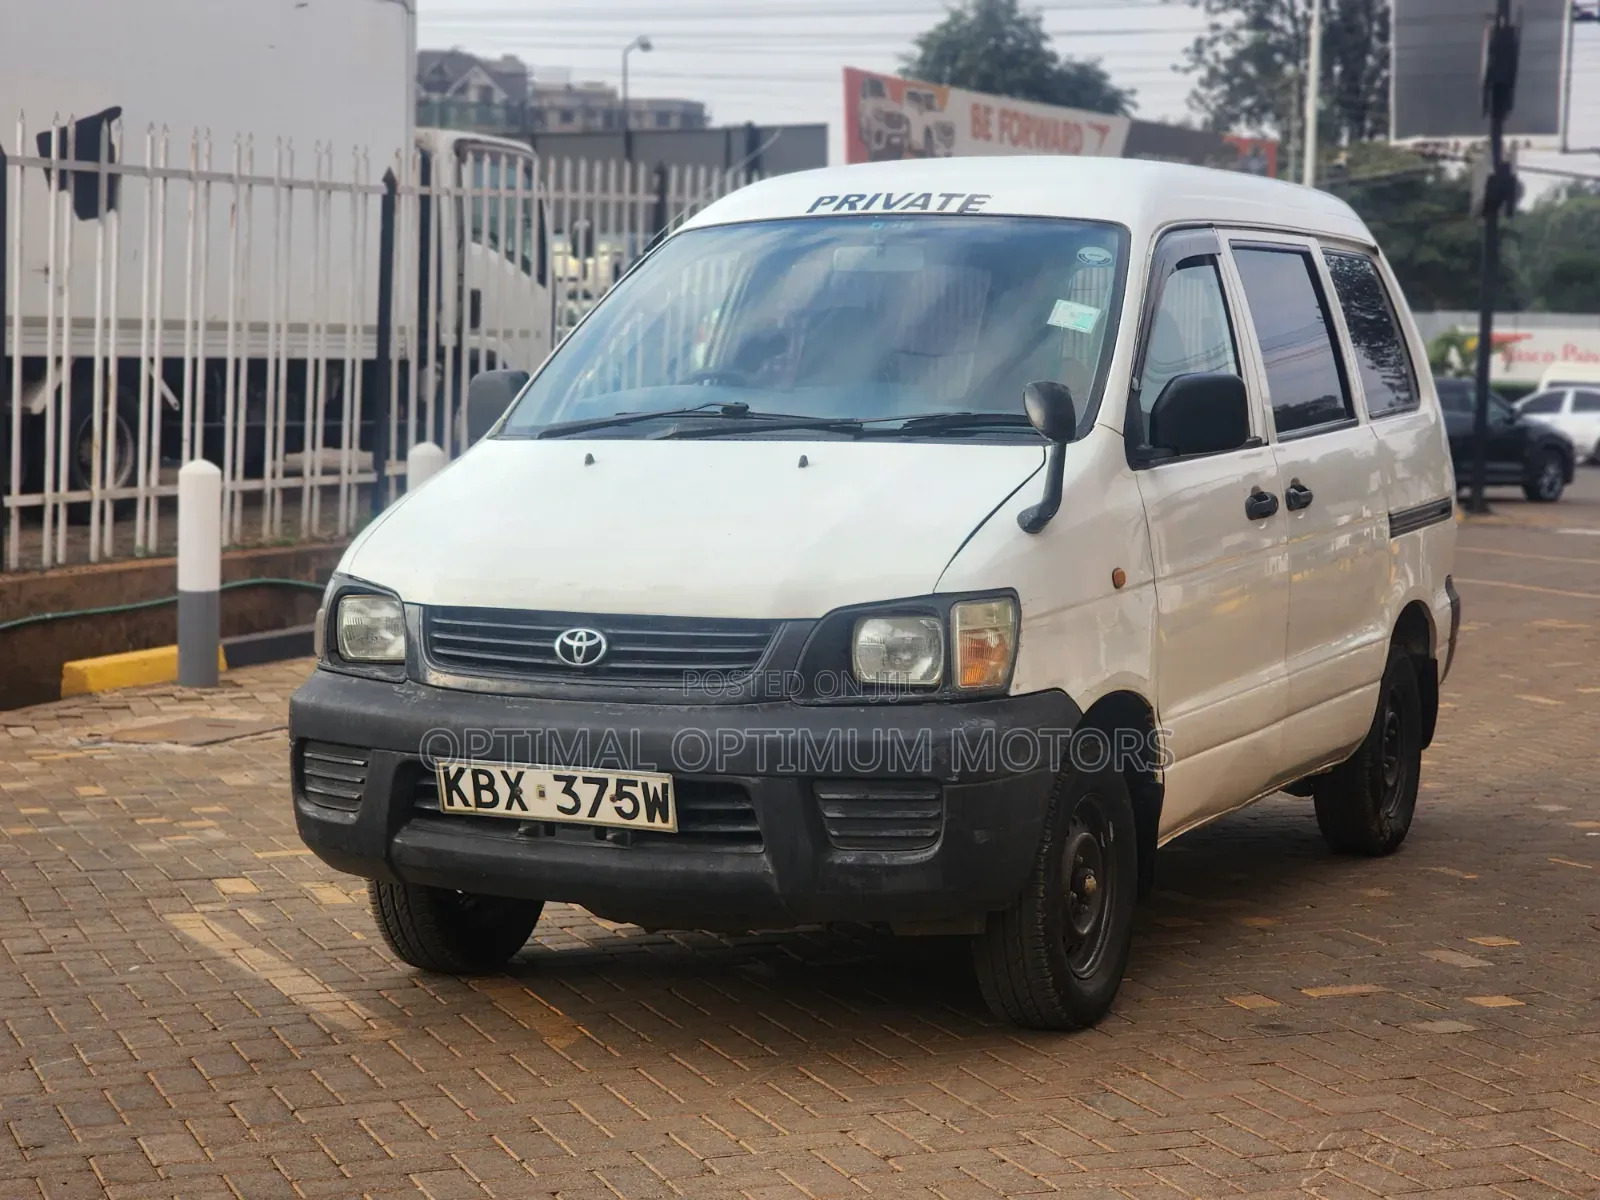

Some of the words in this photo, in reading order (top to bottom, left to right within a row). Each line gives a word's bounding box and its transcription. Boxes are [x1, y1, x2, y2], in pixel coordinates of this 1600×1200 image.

[971, 102, 993, 141] BE
[998, 107, 1084, 155] FORWARD
[806, 192, 993, 214] PRIVATE
[443, 766, 529, 812] KBX
[553, 774, 670, 825] 375W
